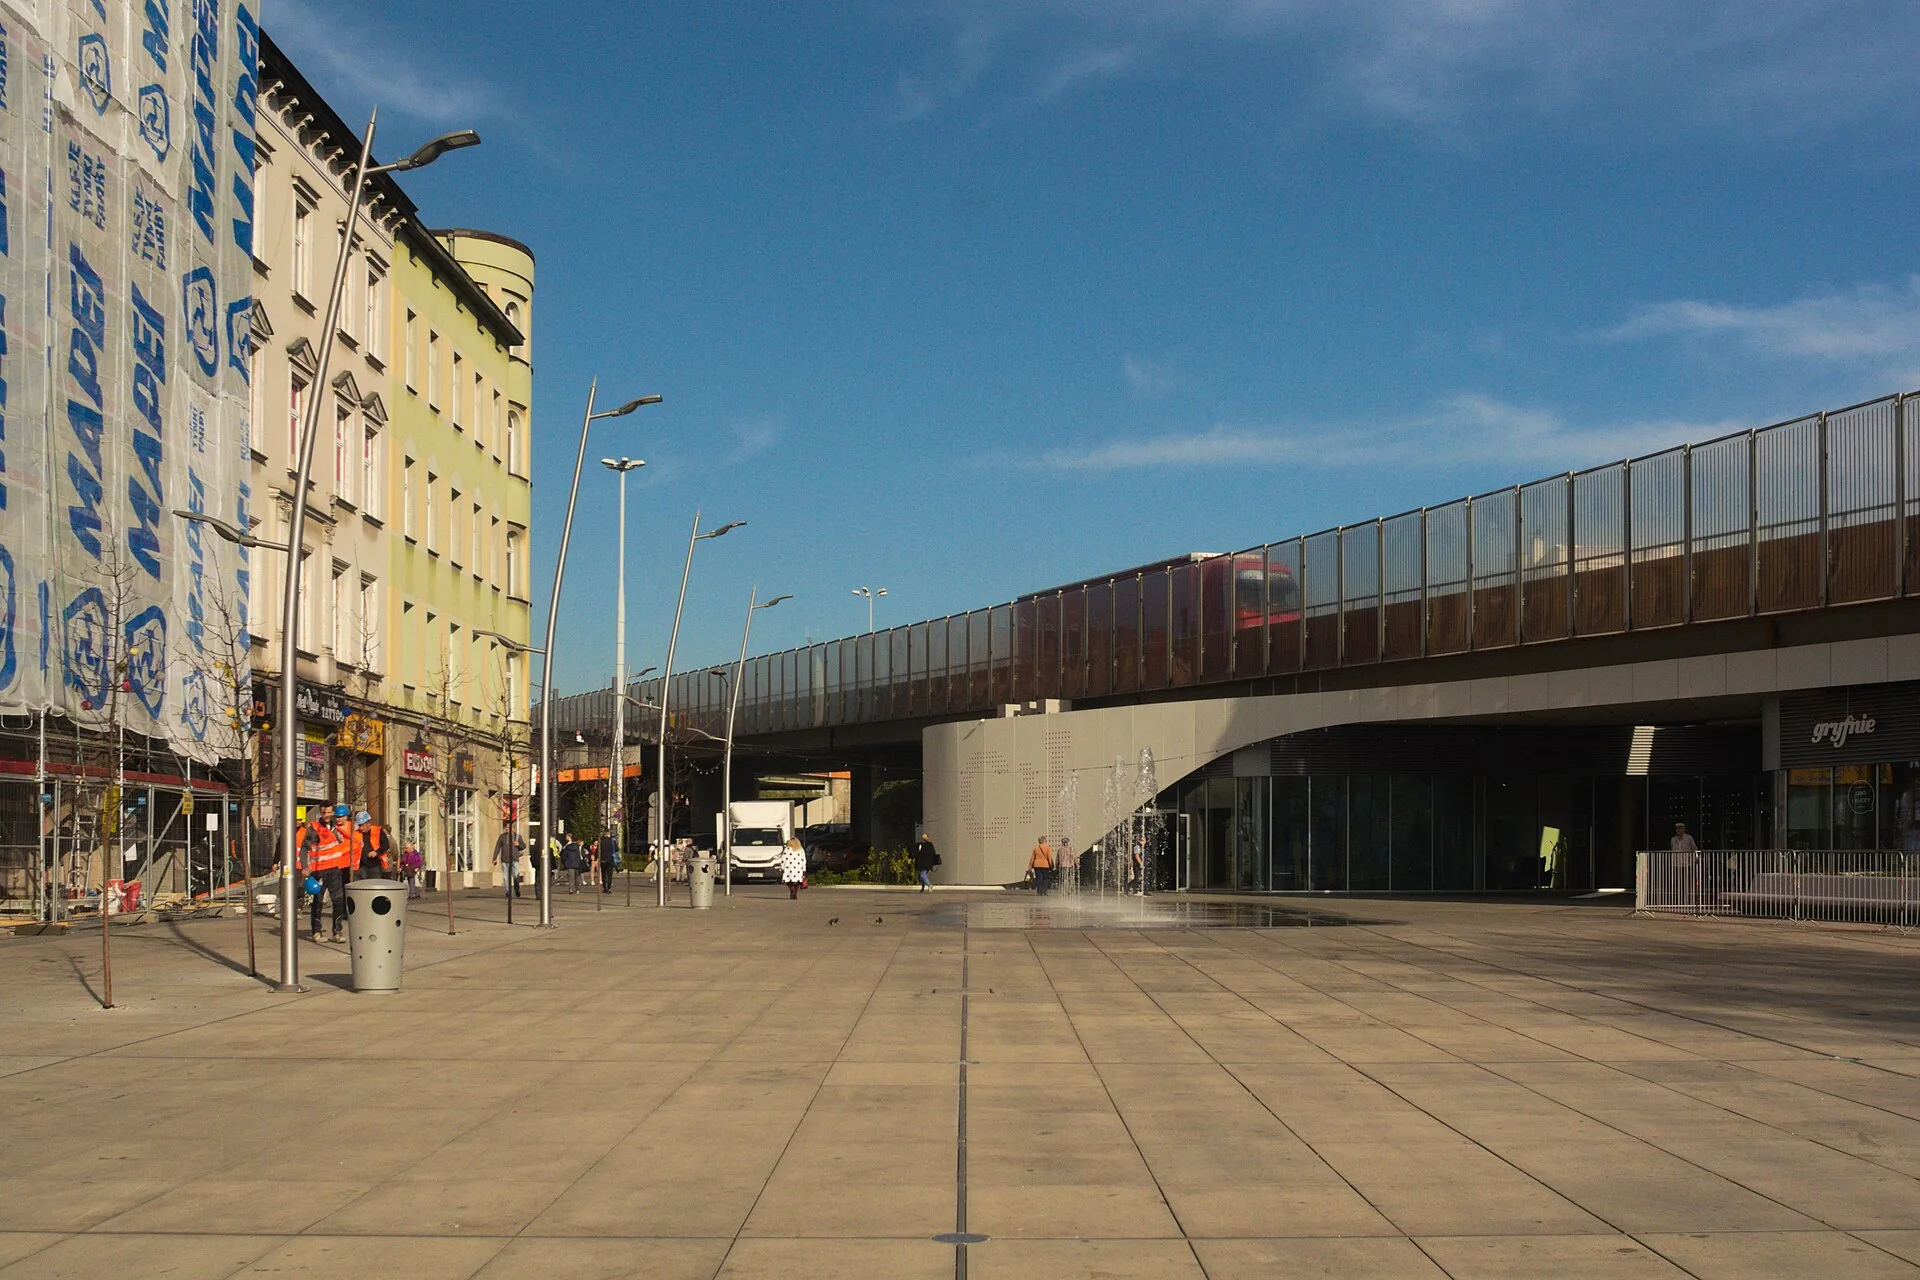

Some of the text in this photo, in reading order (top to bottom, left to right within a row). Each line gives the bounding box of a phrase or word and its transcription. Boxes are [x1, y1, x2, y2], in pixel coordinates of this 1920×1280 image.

[153, 200, 166, 271] FARBY
[67, 240, 104, 562] MAPEI
[128, 280, 165, 583] MAPEI
[186, 465, 205, 655] MAPEI
[1811, 713, 1876, 748] gryfnie
